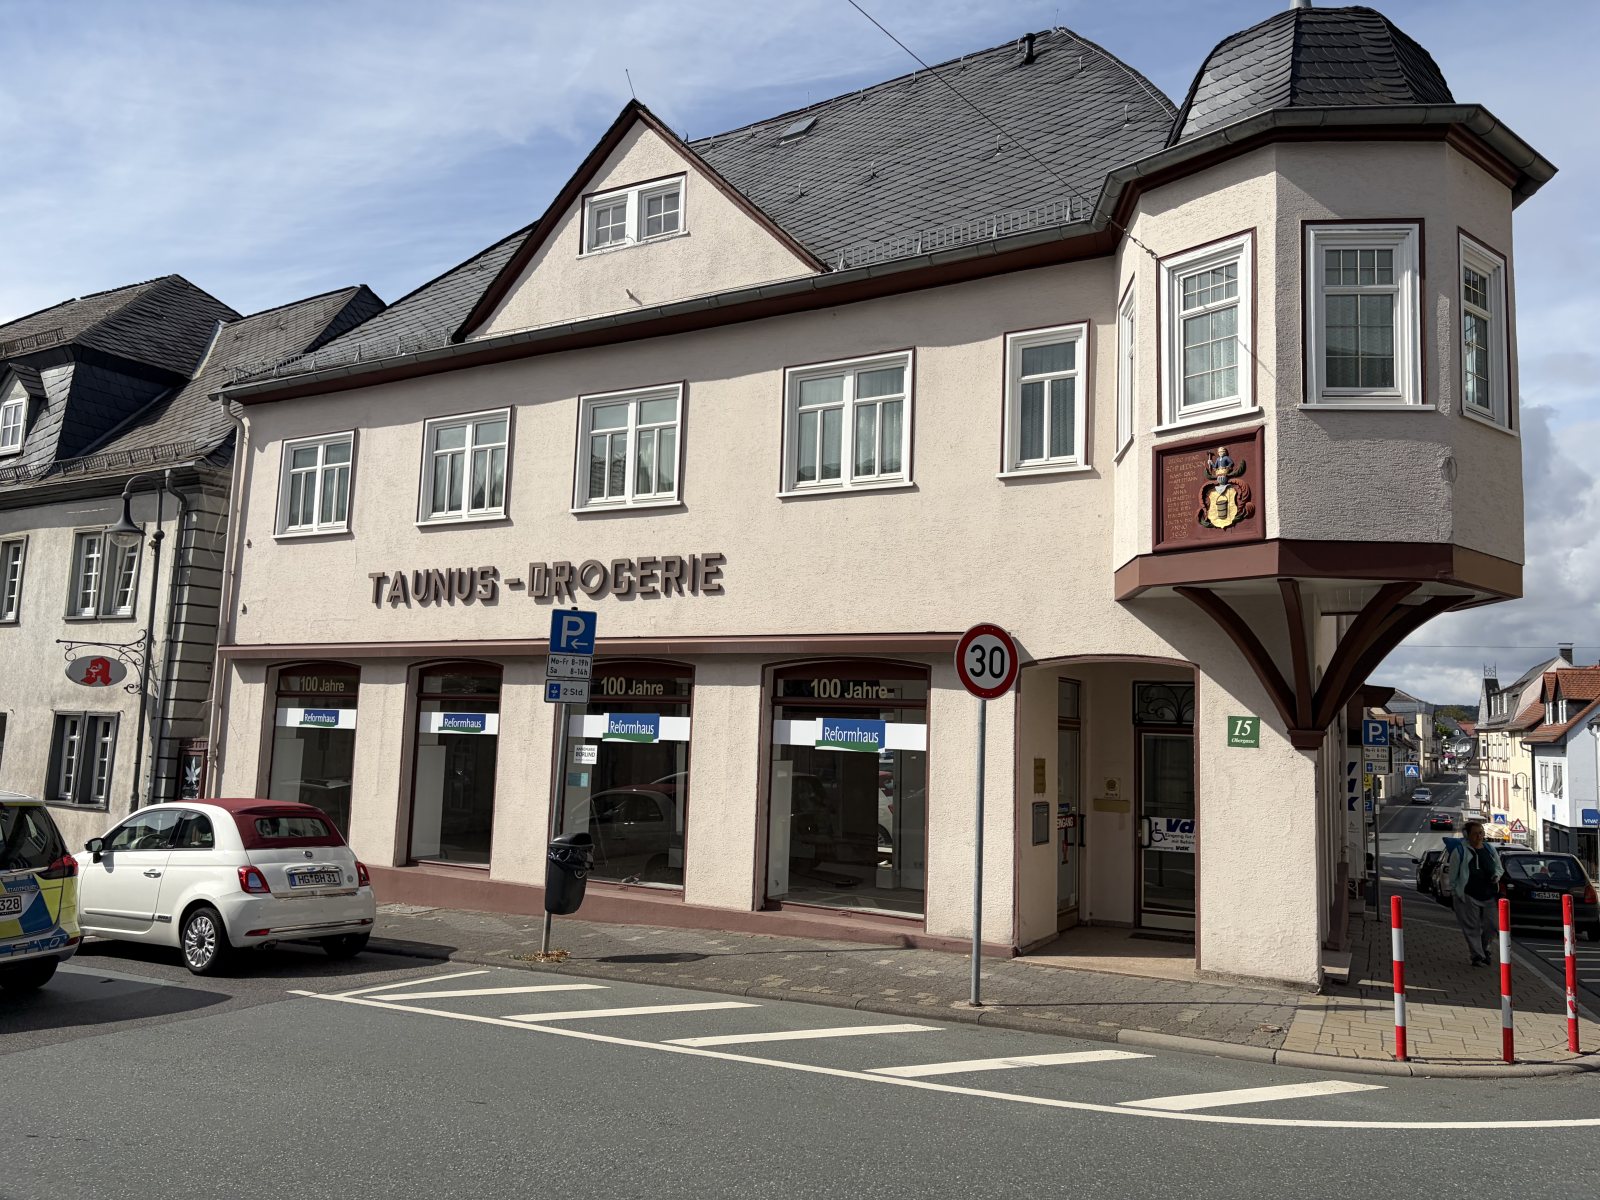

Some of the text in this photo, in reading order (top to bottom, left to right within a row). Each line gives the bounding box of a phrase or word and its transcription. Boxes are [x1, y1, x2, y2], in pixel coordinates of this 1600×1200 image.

[560, 615, 586, 648] P
[969, 644, 1005, 679] 30
[300, 676, 345, 692] 100 Jahre
[563, 688, 568, 696] 2
[601, 676, 664, 696] 100 Jahre
[811, 678, 888, 699] 100 Jahre
[304, 713, 336, 723] Reformhaus
[444, 717, 482, 728] Reformhaus
[609, 720, 655, 735] Reformhaus
[824, 726, 879, 743] Reformhaus
[1232, 720, 1253, 736] 15
[1368, 723, 1383, 742] P
[298, 874, 310, 884] HG
[327, 872, 337, 882] 31
[0, 898, 20, 911] 328
